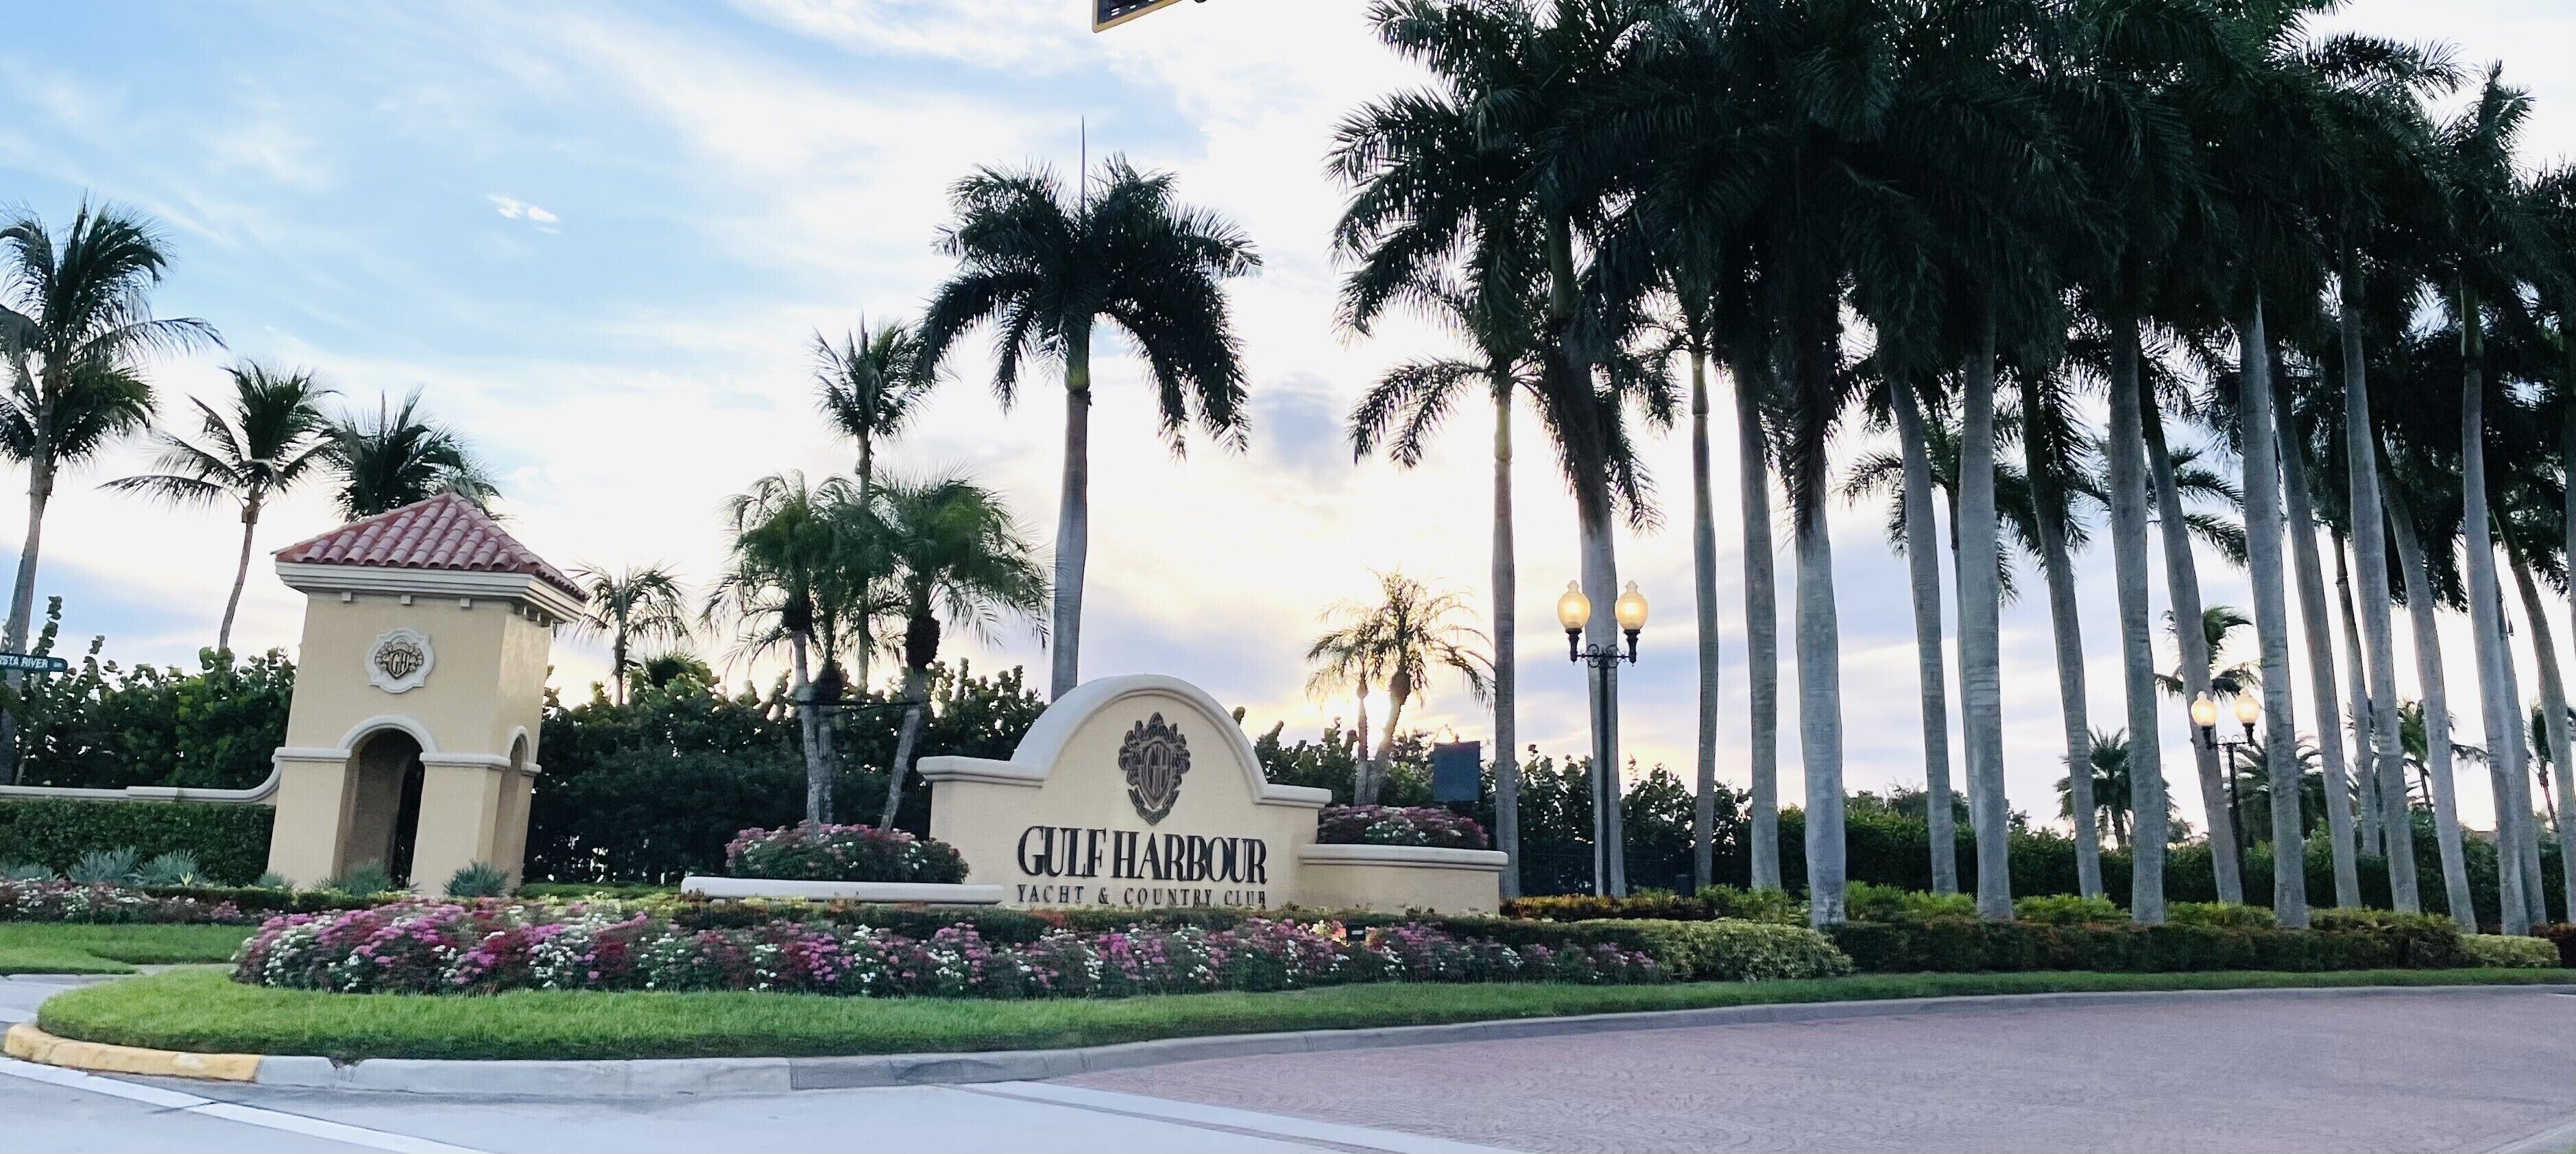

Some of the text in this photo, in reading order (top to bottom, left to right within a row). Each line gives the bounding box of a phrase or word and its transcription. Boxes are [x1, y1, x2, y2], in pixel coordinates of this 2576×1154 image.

[21, 656, 48, 669] RIVER
[1018, 825, 1267, 885] GULF HARBOUR
[1018, 884, 1266, 909] YACHT & COUNTRY CLUB
